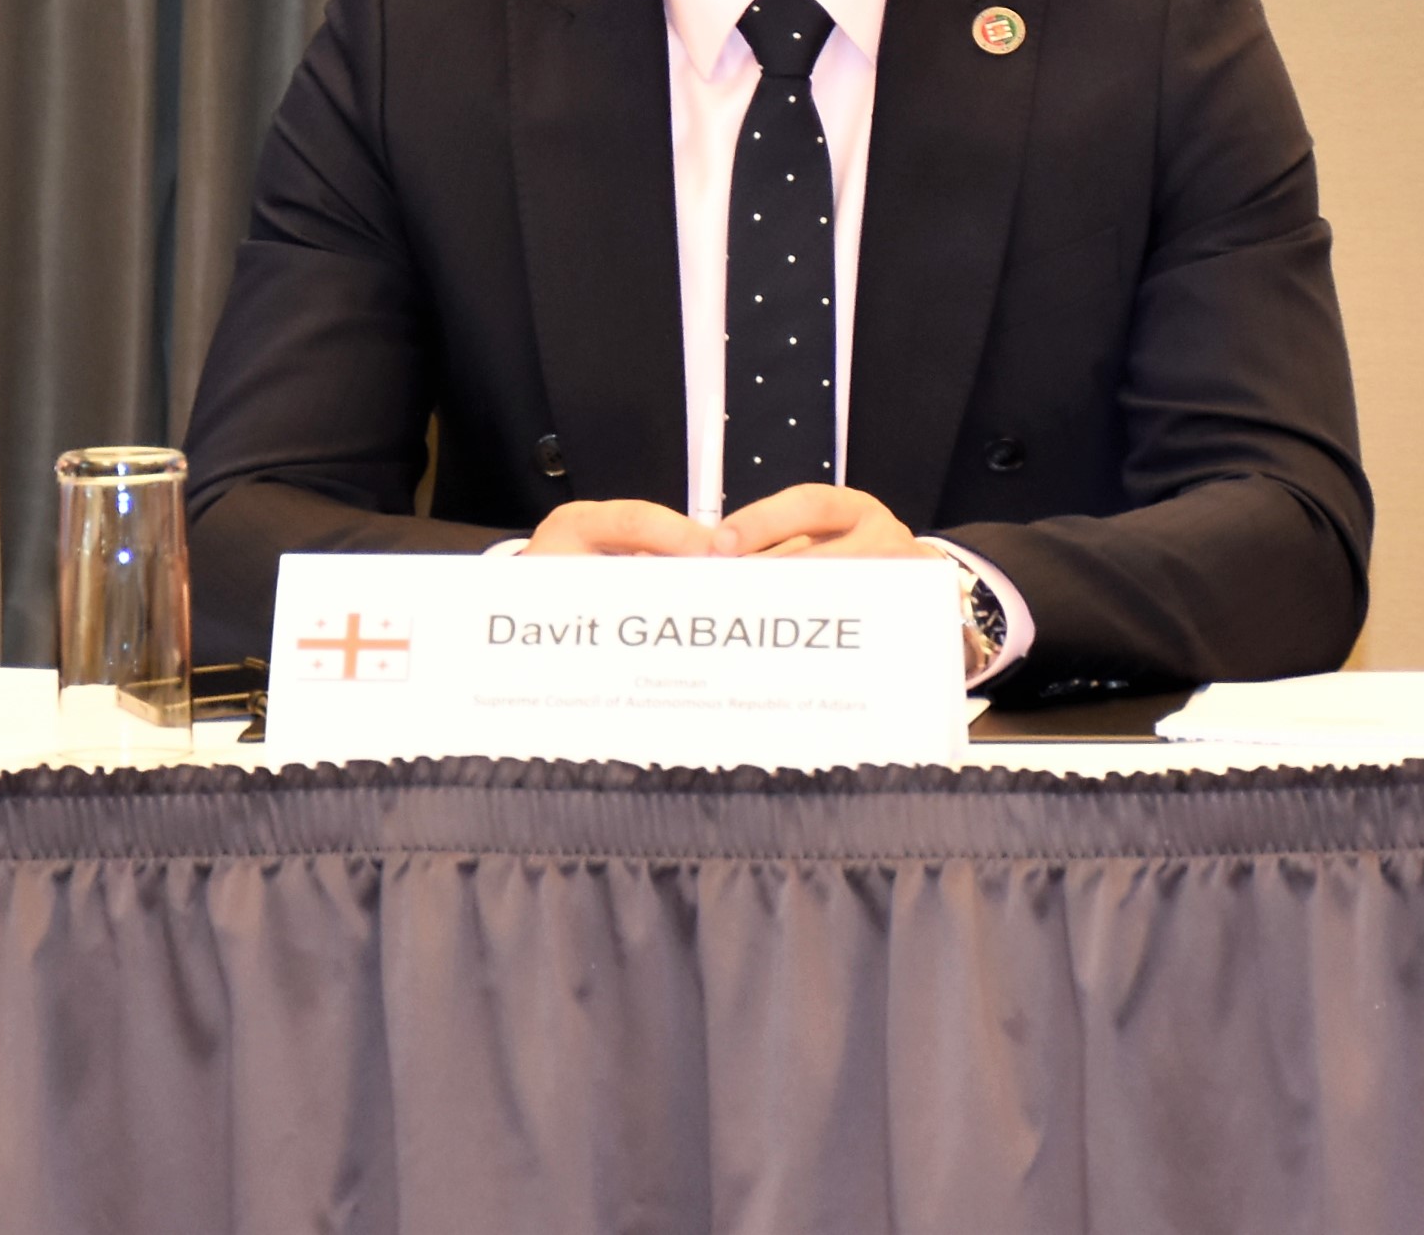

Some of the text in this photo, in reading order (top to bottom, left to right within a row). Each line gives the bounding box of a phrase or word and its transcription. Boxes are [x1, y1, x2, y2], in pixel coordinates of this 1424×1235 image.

[487, 614, 861, 649] Davit GABAIDZE
[633, 676, 708, 690] Chairman
[472, 694, 541, 710] Supreme
[545, 694, 601, 708] Council
[605, 694, 621, 708] of
[625, 695, 724, 710] Autonomous
[728, 696, 792, 712] Republic
[797, 697, 814, 711] of
